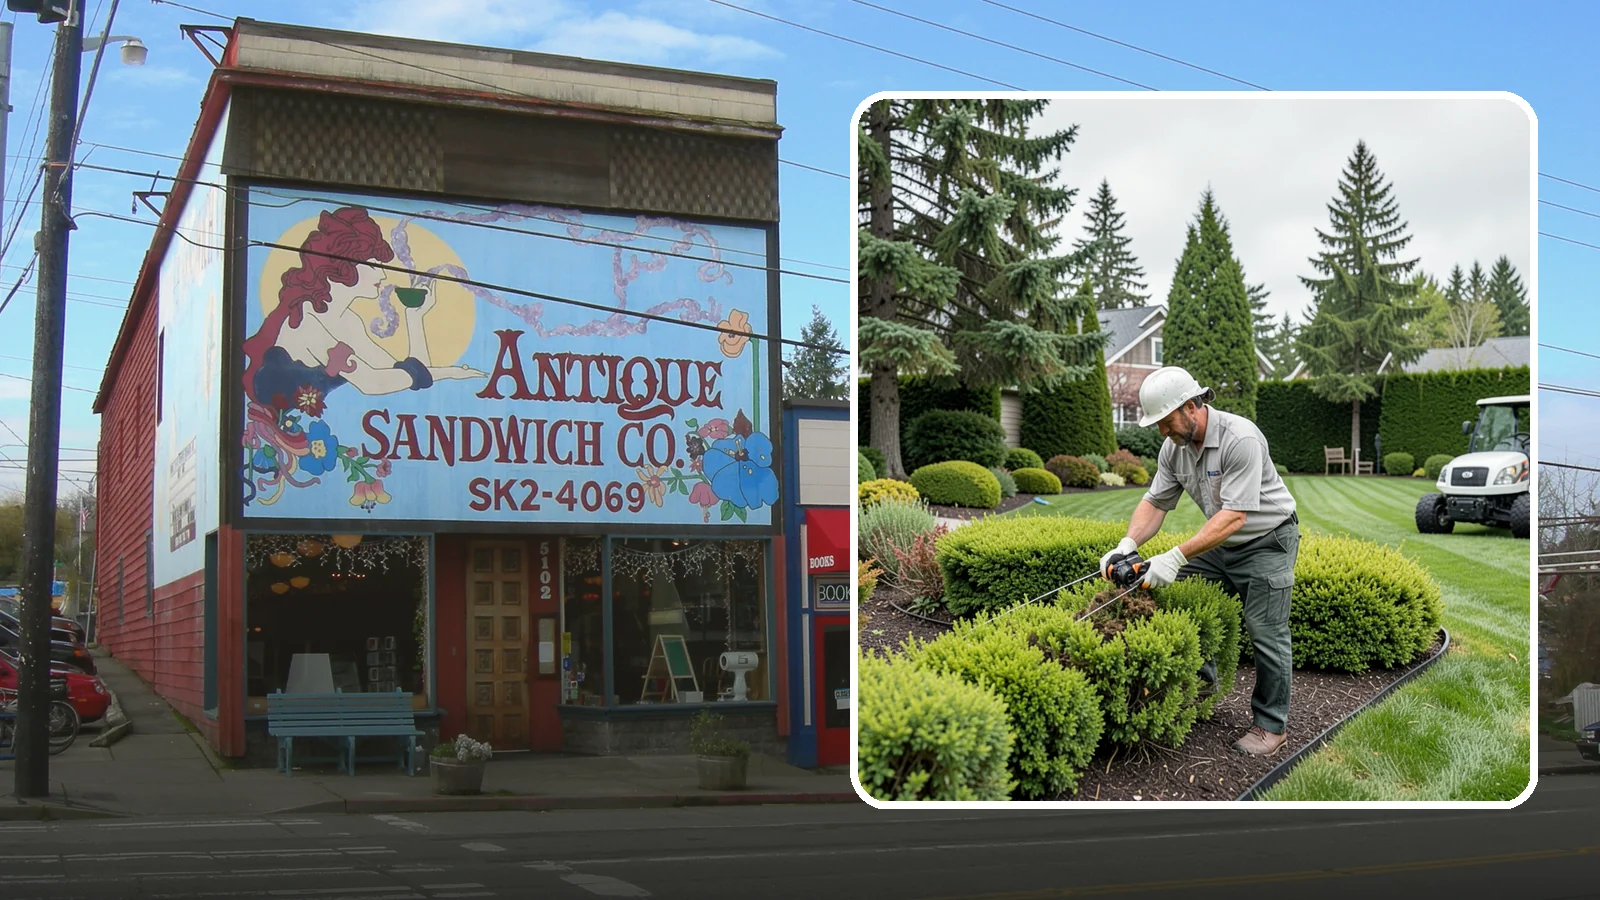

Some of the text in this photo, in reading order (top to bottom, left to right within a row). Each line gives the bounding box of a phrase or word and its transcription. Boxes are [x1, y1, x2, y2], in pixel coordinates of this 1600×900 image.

[475, 329, 724, 421] ANTIQUE
[360, 408, 685, 469] SANDWICH CO.
[468, 477, 646, 513] SK2-4069
[540, 541, 551, 600] 5102
[809, 555, 834, 569] BOOKS
